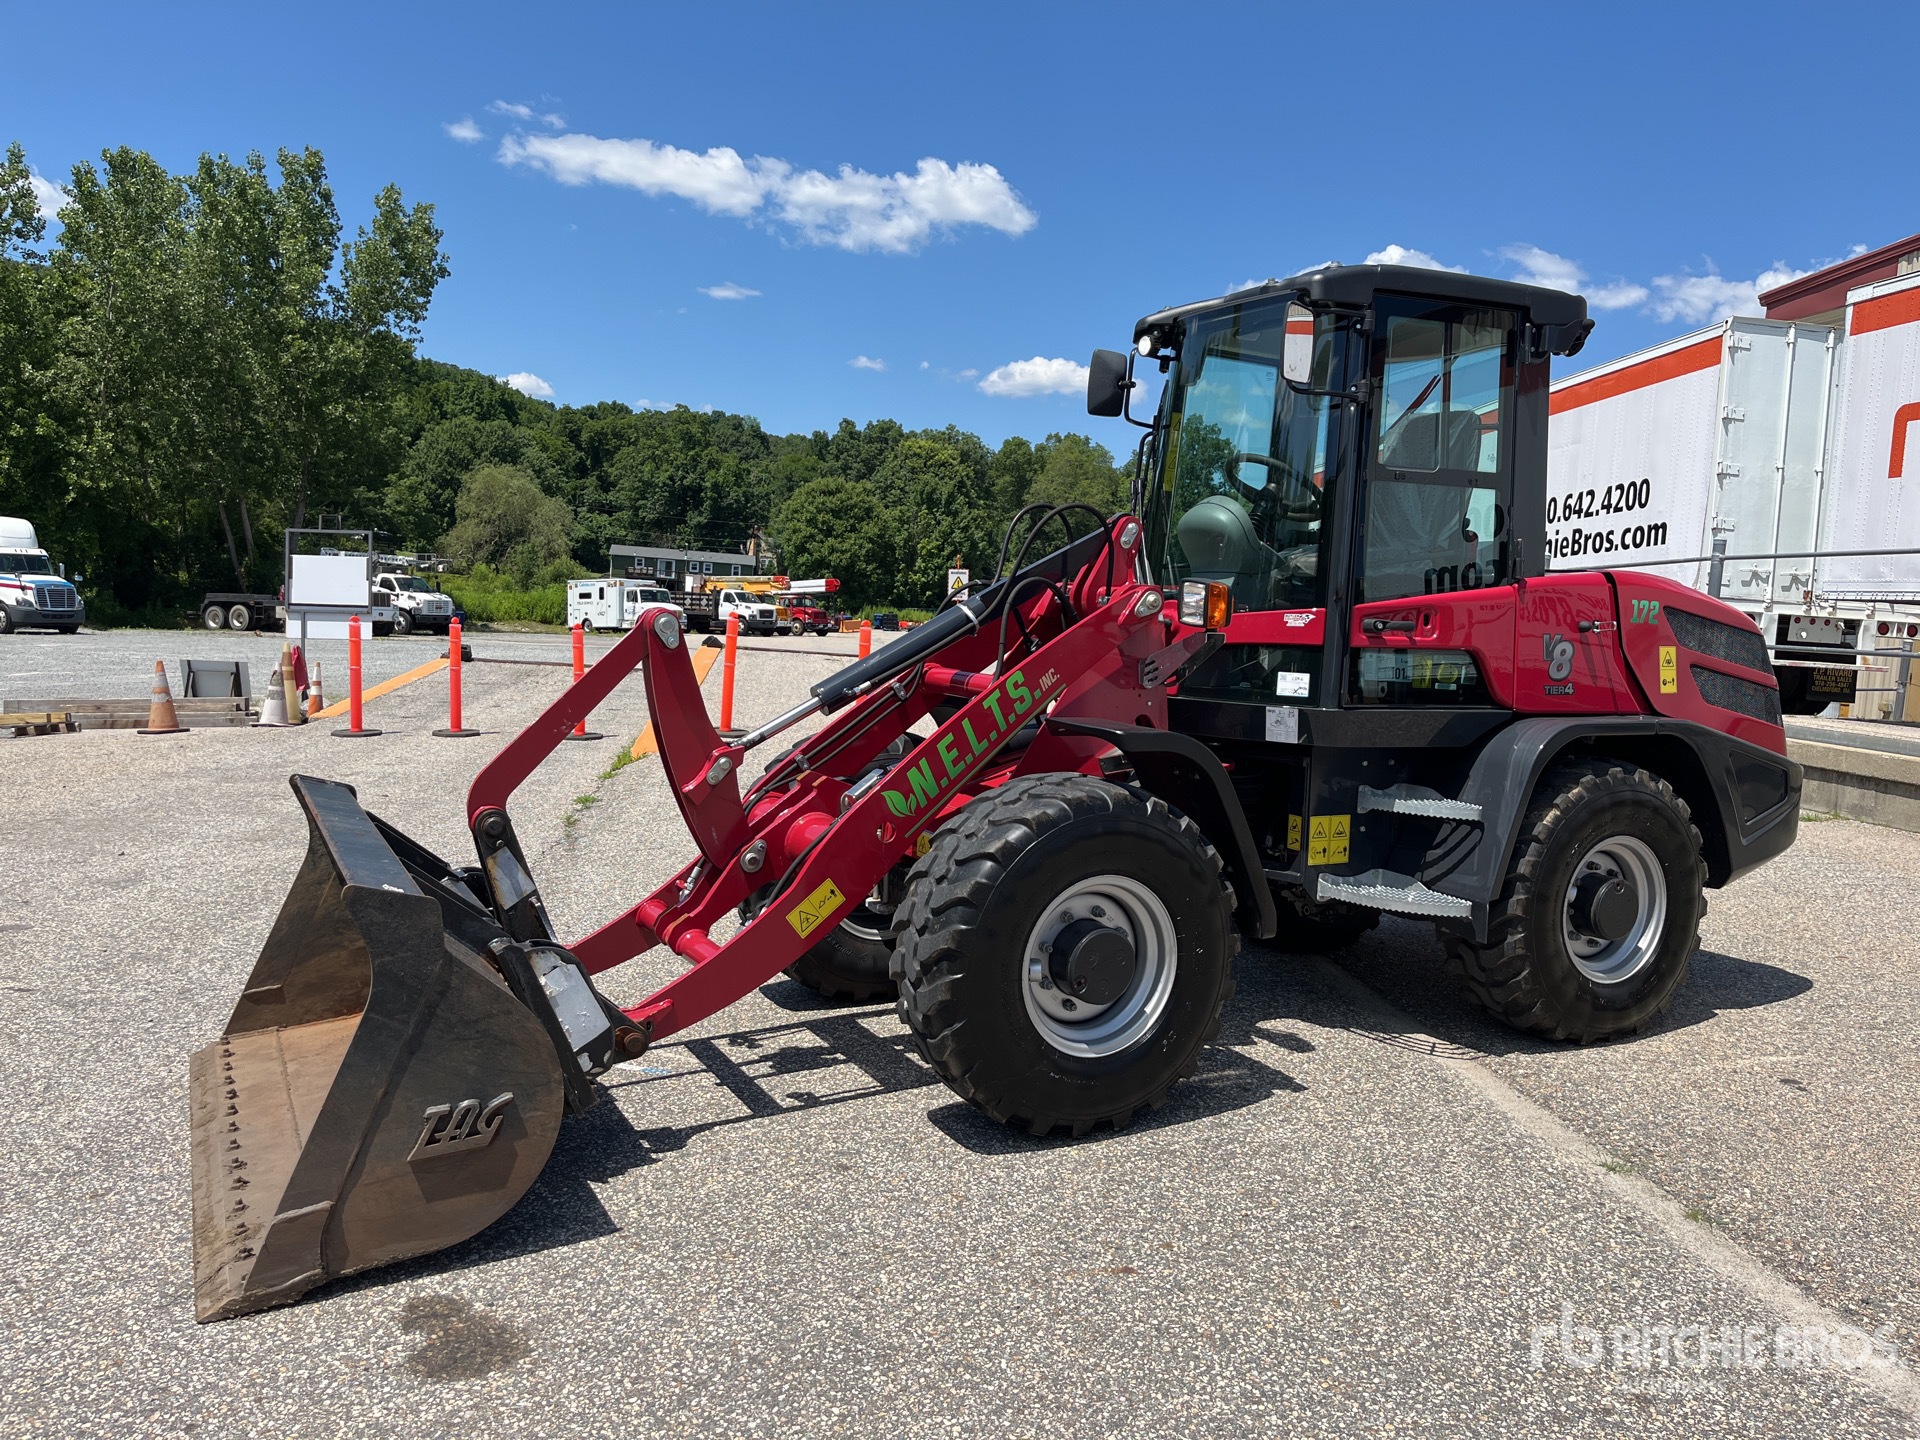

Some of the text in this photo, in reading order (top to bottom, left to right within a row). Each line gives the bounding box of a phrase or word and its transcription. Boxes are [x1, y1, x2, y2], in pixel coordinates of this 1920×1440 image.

[1630, 599, 1660, 624] 172
[1543, 633, 1575, 682] V8
[1039, 668, 1060, 692] INC.
[1813, 674, 1836, 682] TRAILER
[1827, 668, 1853, 678] RIVARD
[1544, 682, 1574, 695] TIER4
